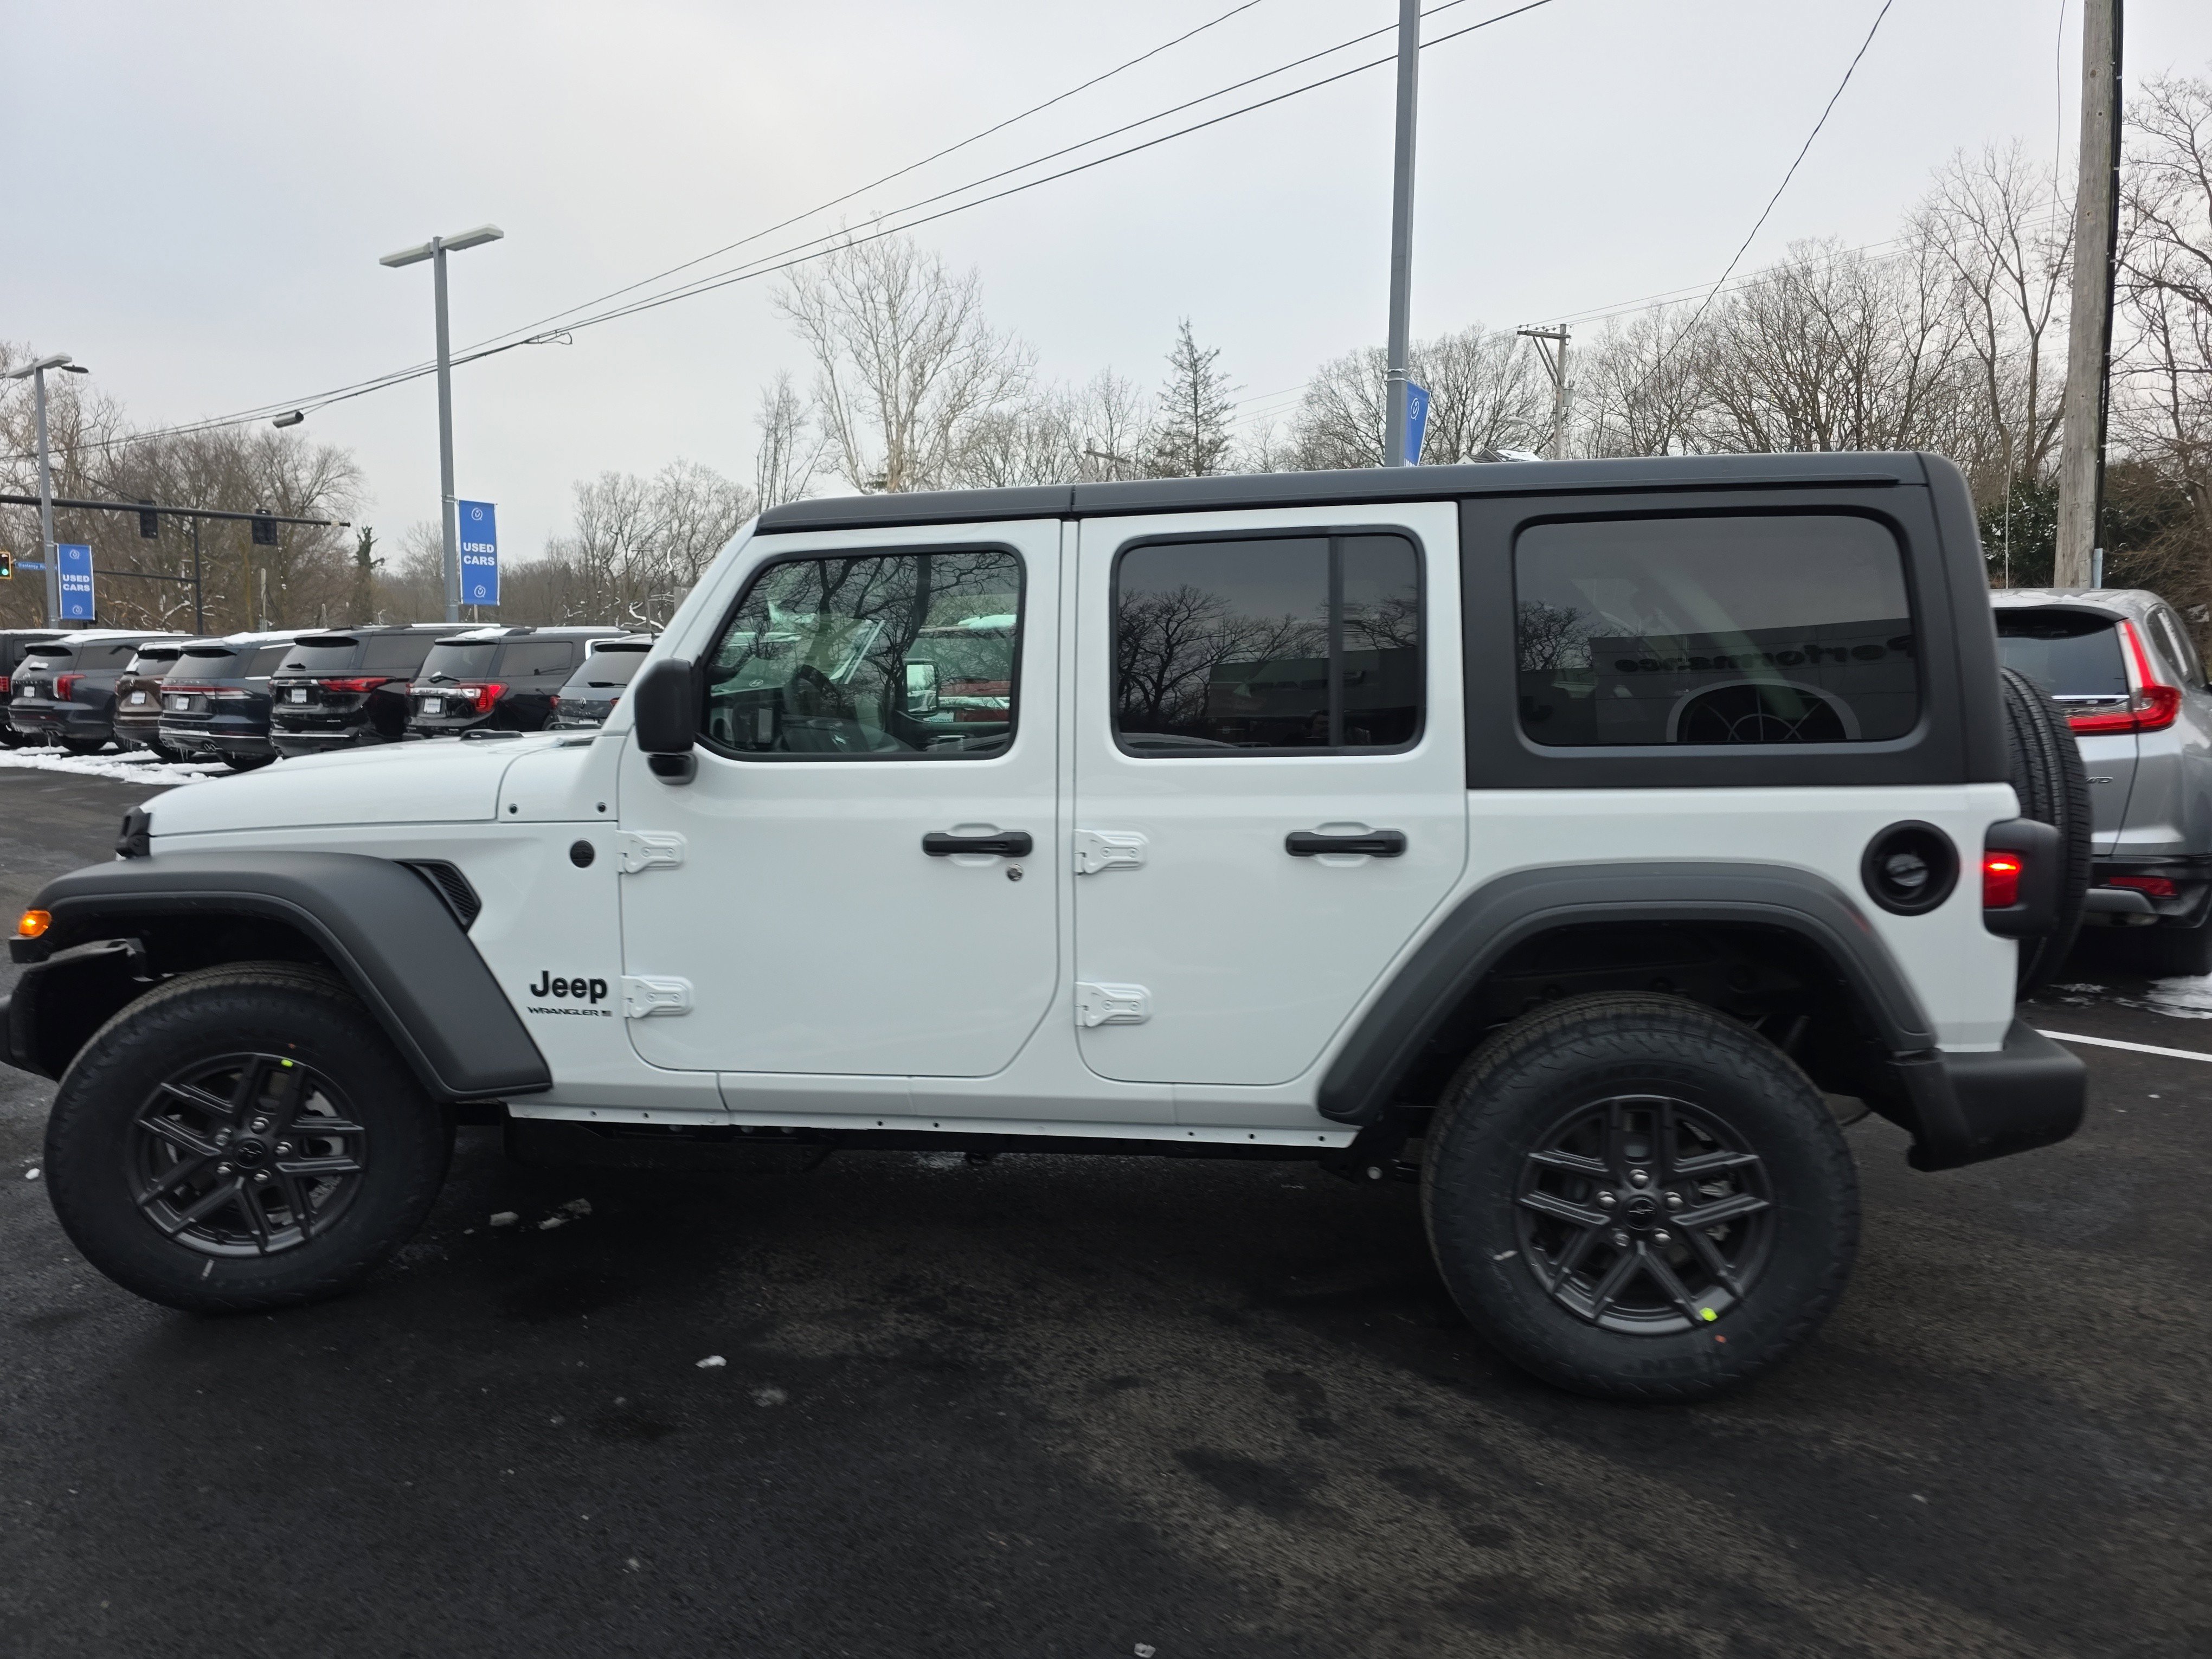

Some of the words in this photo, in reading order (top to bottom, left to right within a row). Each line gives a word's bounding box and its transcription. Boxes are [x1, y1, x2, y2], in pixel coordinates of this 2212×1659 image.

[463, 542, 494, 553] USED
[464, 555, 495, 566] CARS
[62, 574, 90, 582] USED
[530, 970, 608, 1004] Jeep
[526, 1006, 599, 1017] WRANGLER
